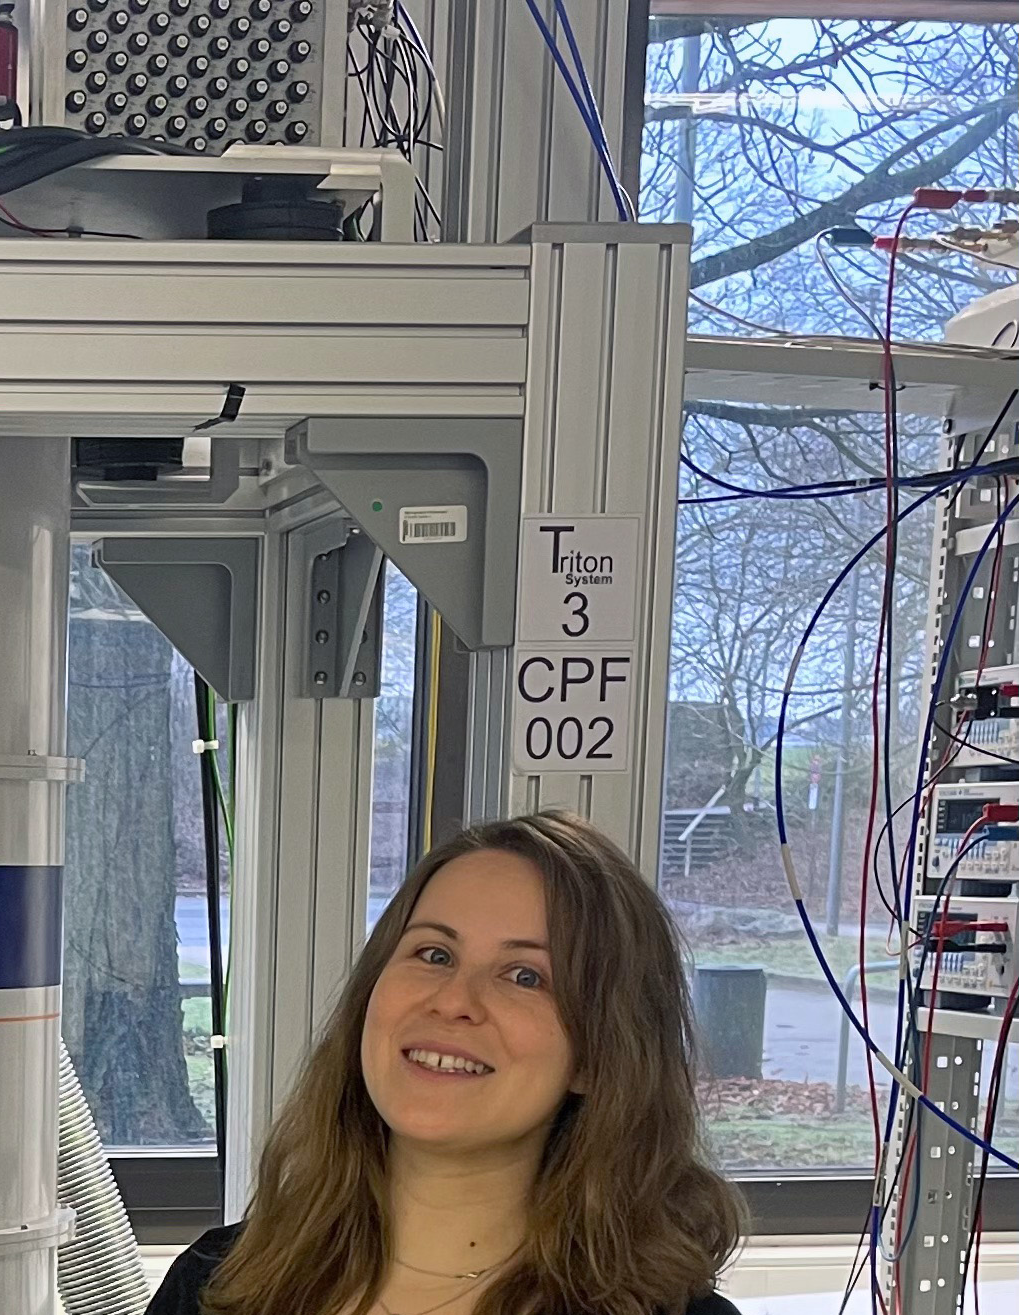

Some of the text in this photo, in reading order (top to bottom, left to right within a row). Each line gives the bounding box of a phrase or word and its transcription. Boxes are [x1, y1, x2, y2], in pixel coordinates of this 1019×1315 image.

[539, 526, 613, 574] Triton
[565, 573, 613, 586] System
[561, 592, 590, 637] 3
[518, 656, 630, 703] CPF
[526, 716, 614, 760] 002
